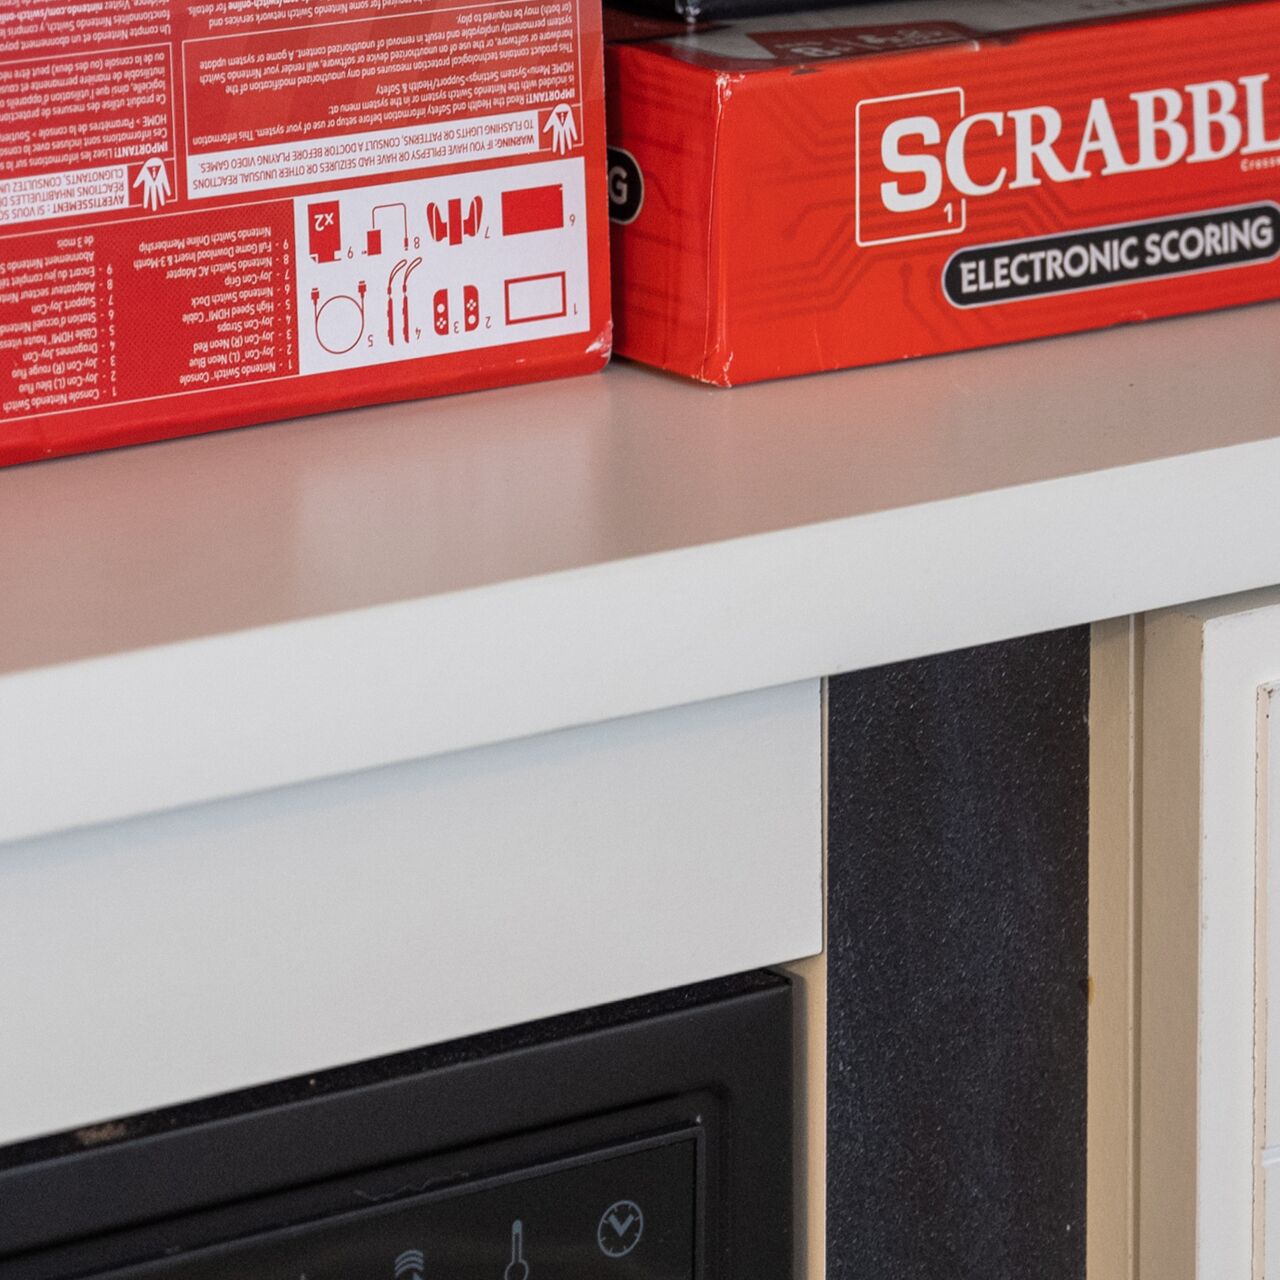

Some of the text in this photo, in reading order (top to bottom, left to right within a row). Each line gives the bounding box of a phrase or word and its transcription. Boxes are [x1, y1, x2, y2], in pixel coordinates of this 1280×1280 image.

[525, 87, 575, 104] IMPORTANT!
[455, 124, 483, 139] LIGHTS
[483, 120, 522, 135] FLASHING
[522, 118, 533, 130] TO
[401, 131, 442, 146] PATTERNS,
[442, 128, 455, 141] OR
[323, 141, 357, 157] DOCTOR
[356, 141, 364, 152] A
[364, 136, 400, 151] CONSULT
[256, 151, 290, 165] PLAYING
[291, 146, 323, 161] BEFORE
[192, 134, 534, 190] WARNING: IF YOU HAVE EPILEPSY OR HAVE HAD SEIZURES OR OTHER UNUSUAL REACTIONS
[229, 156, 256, 169] VIDEO
[52, 194, 124, 213] AVERTISSEMENT
[313, 212, 334, 231] x2
[568, 213, 576, 226] 6
[138, 226, 271, 253] Nintendo Switch Online Membership
[483, 225, 490, 239] 7
[413, 235, 420, 249] 8
[132, 241, 272, 270] Full Game Download Insert & 3-Month
[346, 245, 354, 259] 9
[961, 216, 1272, 292] ELECTRONIC SCORING
[165, 256, 272, 279] Nintendo Switch AC Adapter
[223, 270, 272, 287] Joy-Con Grip
[190, 286, 273, 308] Nintendo Switch Dock
[230, 302, 255, 317] Speed
[255, 299, 274, 313] High
[572, 302, 578, 315] 1
[181, 311, 204, 324] Cable
[216, 315, 273, 332] Joy-Con Straps
[484, 315, 492, 329] 2
[414, 326, 421, 340] 4
[452, 319, 459, 334] 3
[192, 330, 273, 353] Joy-Con (R) Neon Red
[366, 333, 373, 348] 5
[188, 356, 206, 368] Blue
[206, 353, 227, 365] Neon
[227, 349, 240, 363] (L)
[240, 361, 276, 376] Nintendo
[178, 371, 209, 385] Console
